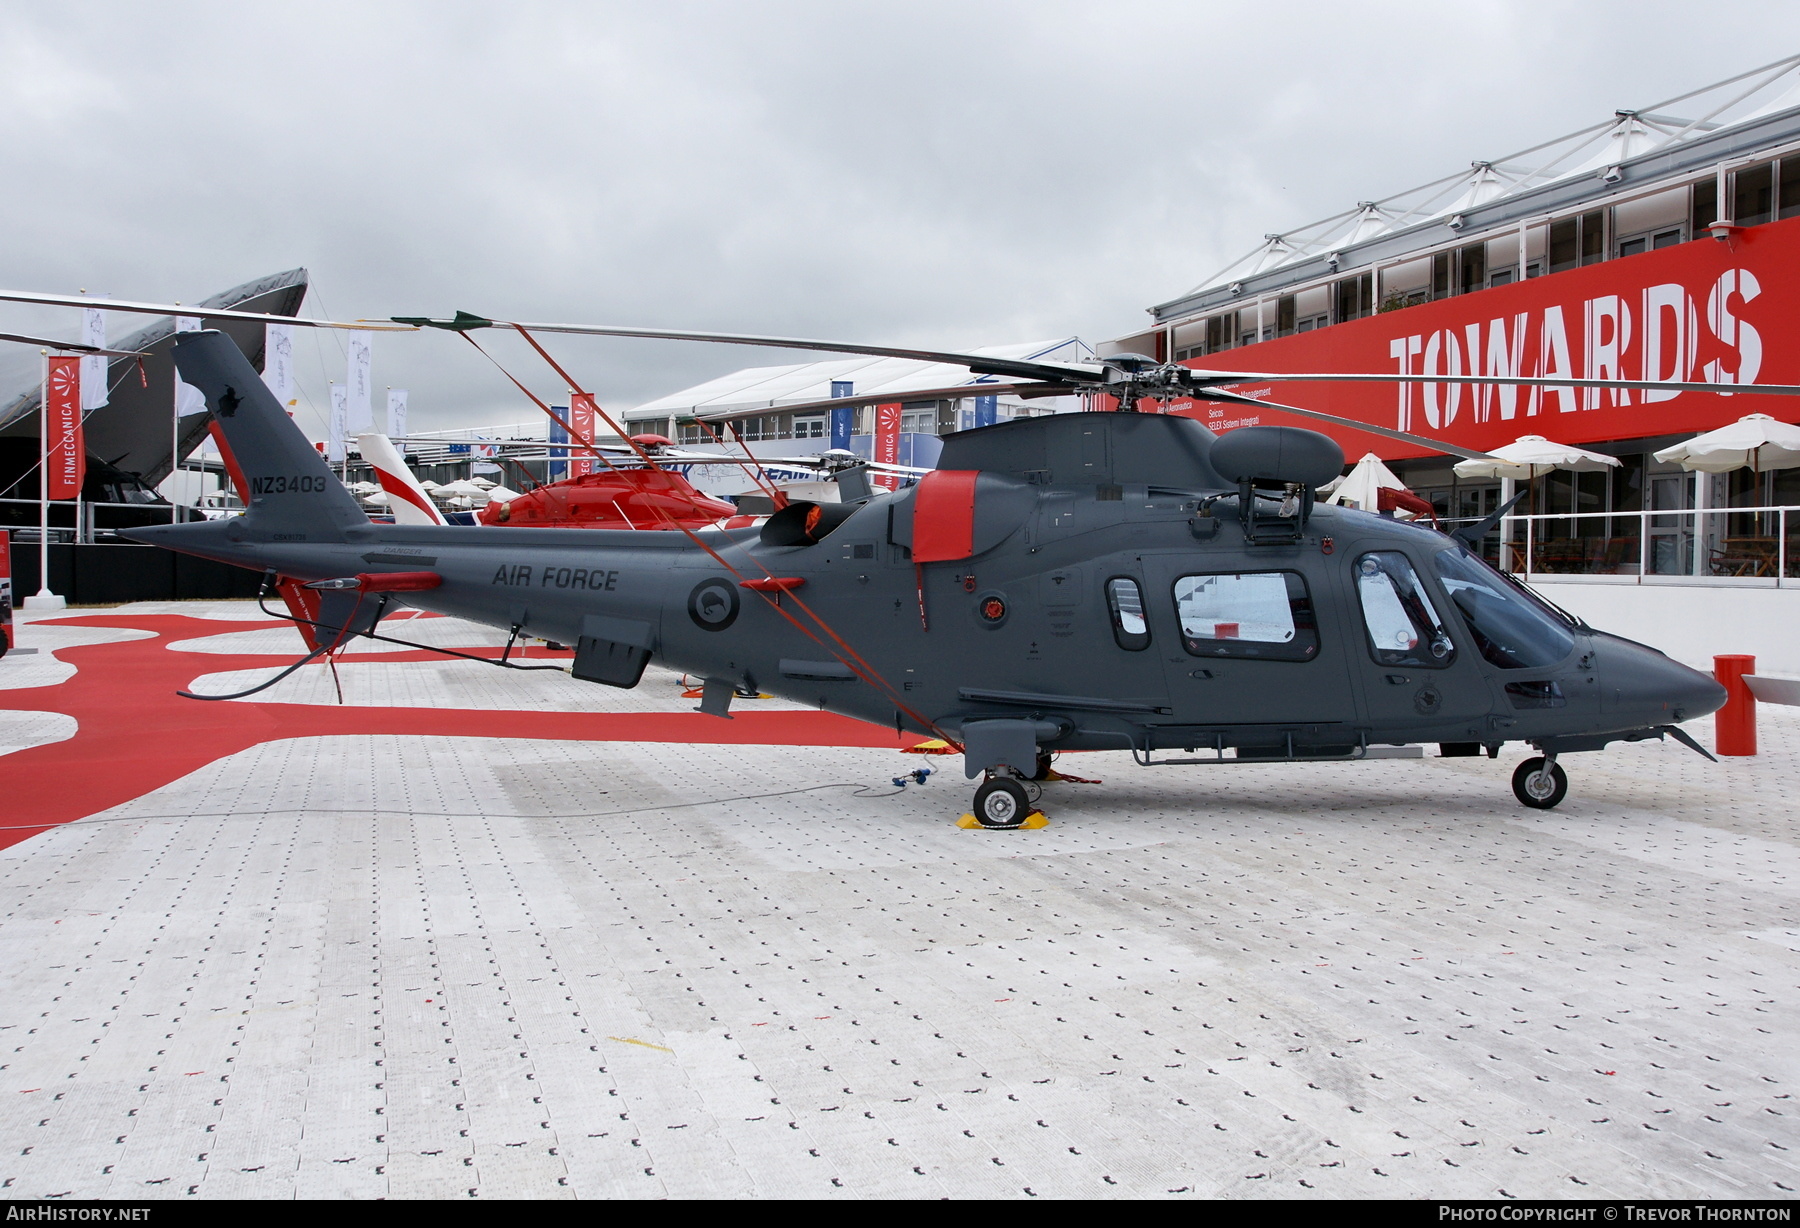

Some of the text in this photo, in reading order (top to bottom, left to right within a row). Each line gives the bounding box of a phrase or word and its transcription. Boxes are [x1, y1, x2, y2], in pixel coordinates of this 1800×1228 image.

[1390, 267, 1763, 432] TOWARDS
[1208, 419, 1223, 431] SELEX
[61, 402, 76, 485] FINMECCANICA
[252, 475, 327, 495] NZ3403
[383, 547, 422, 555] DANGER
[491, 564, 620, 591] AIR FORCE
